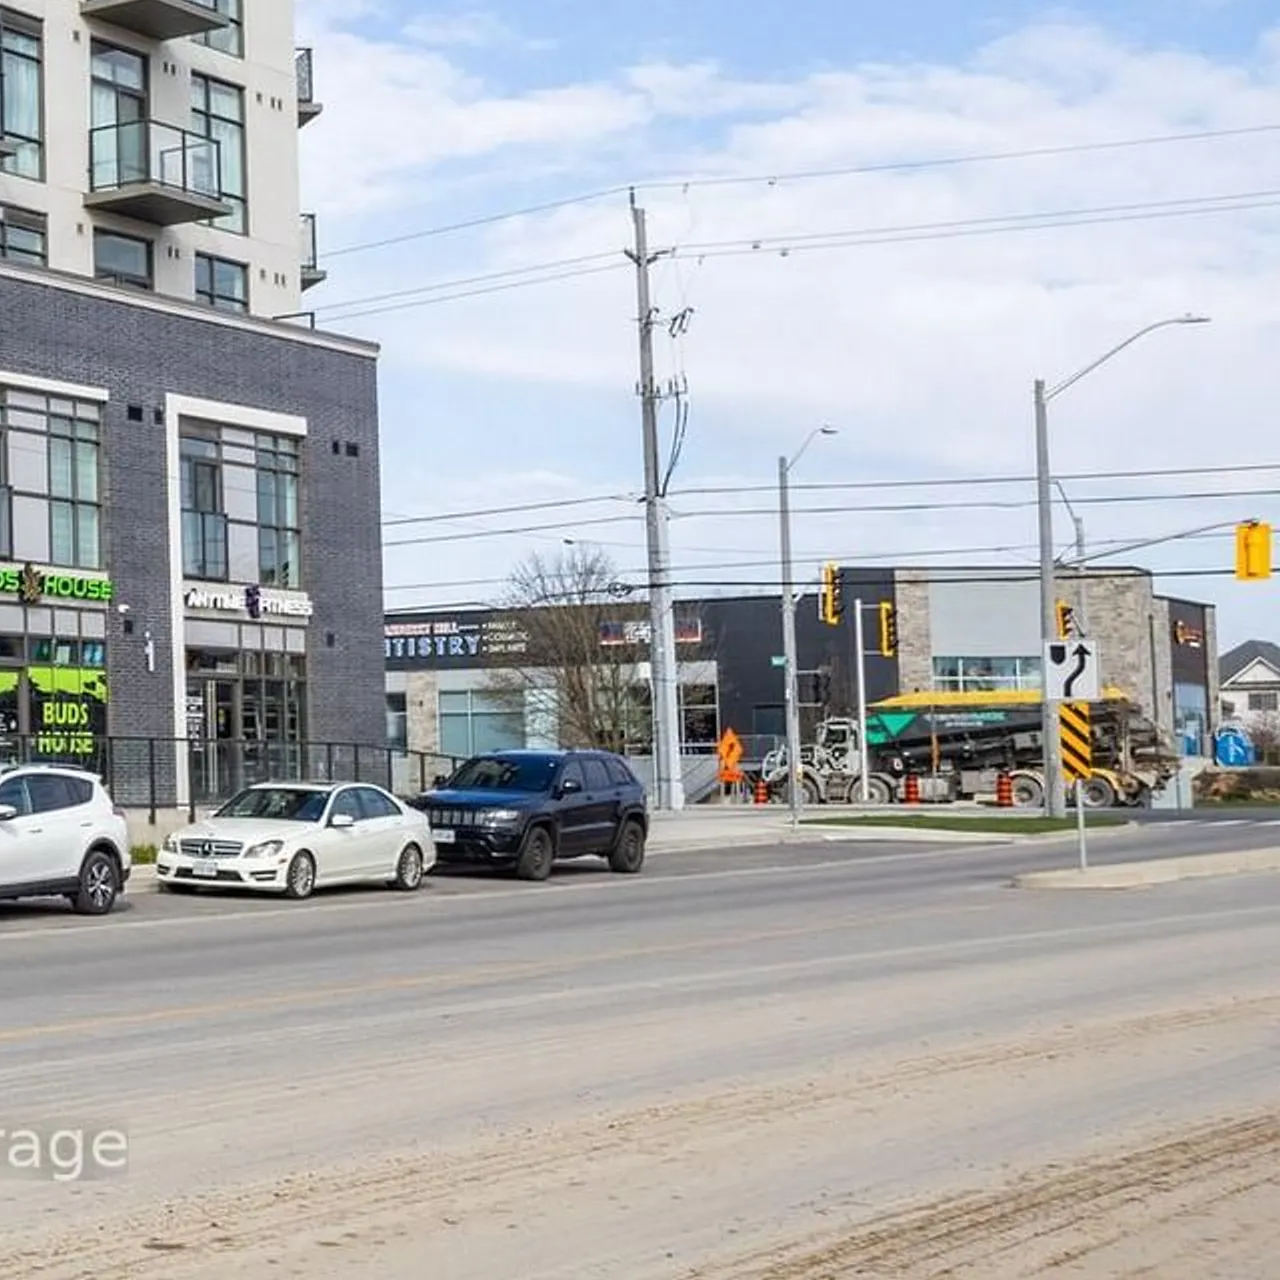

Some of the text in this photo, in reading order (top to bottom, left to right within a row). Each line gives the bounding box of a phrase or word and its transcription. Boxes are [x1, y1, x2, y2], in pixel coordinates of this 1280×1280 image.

[42, 574, 113, 600] HOUSE
[43, 702, 89, 724] BUDS
[38, 731, 94, 754] HOUSE
